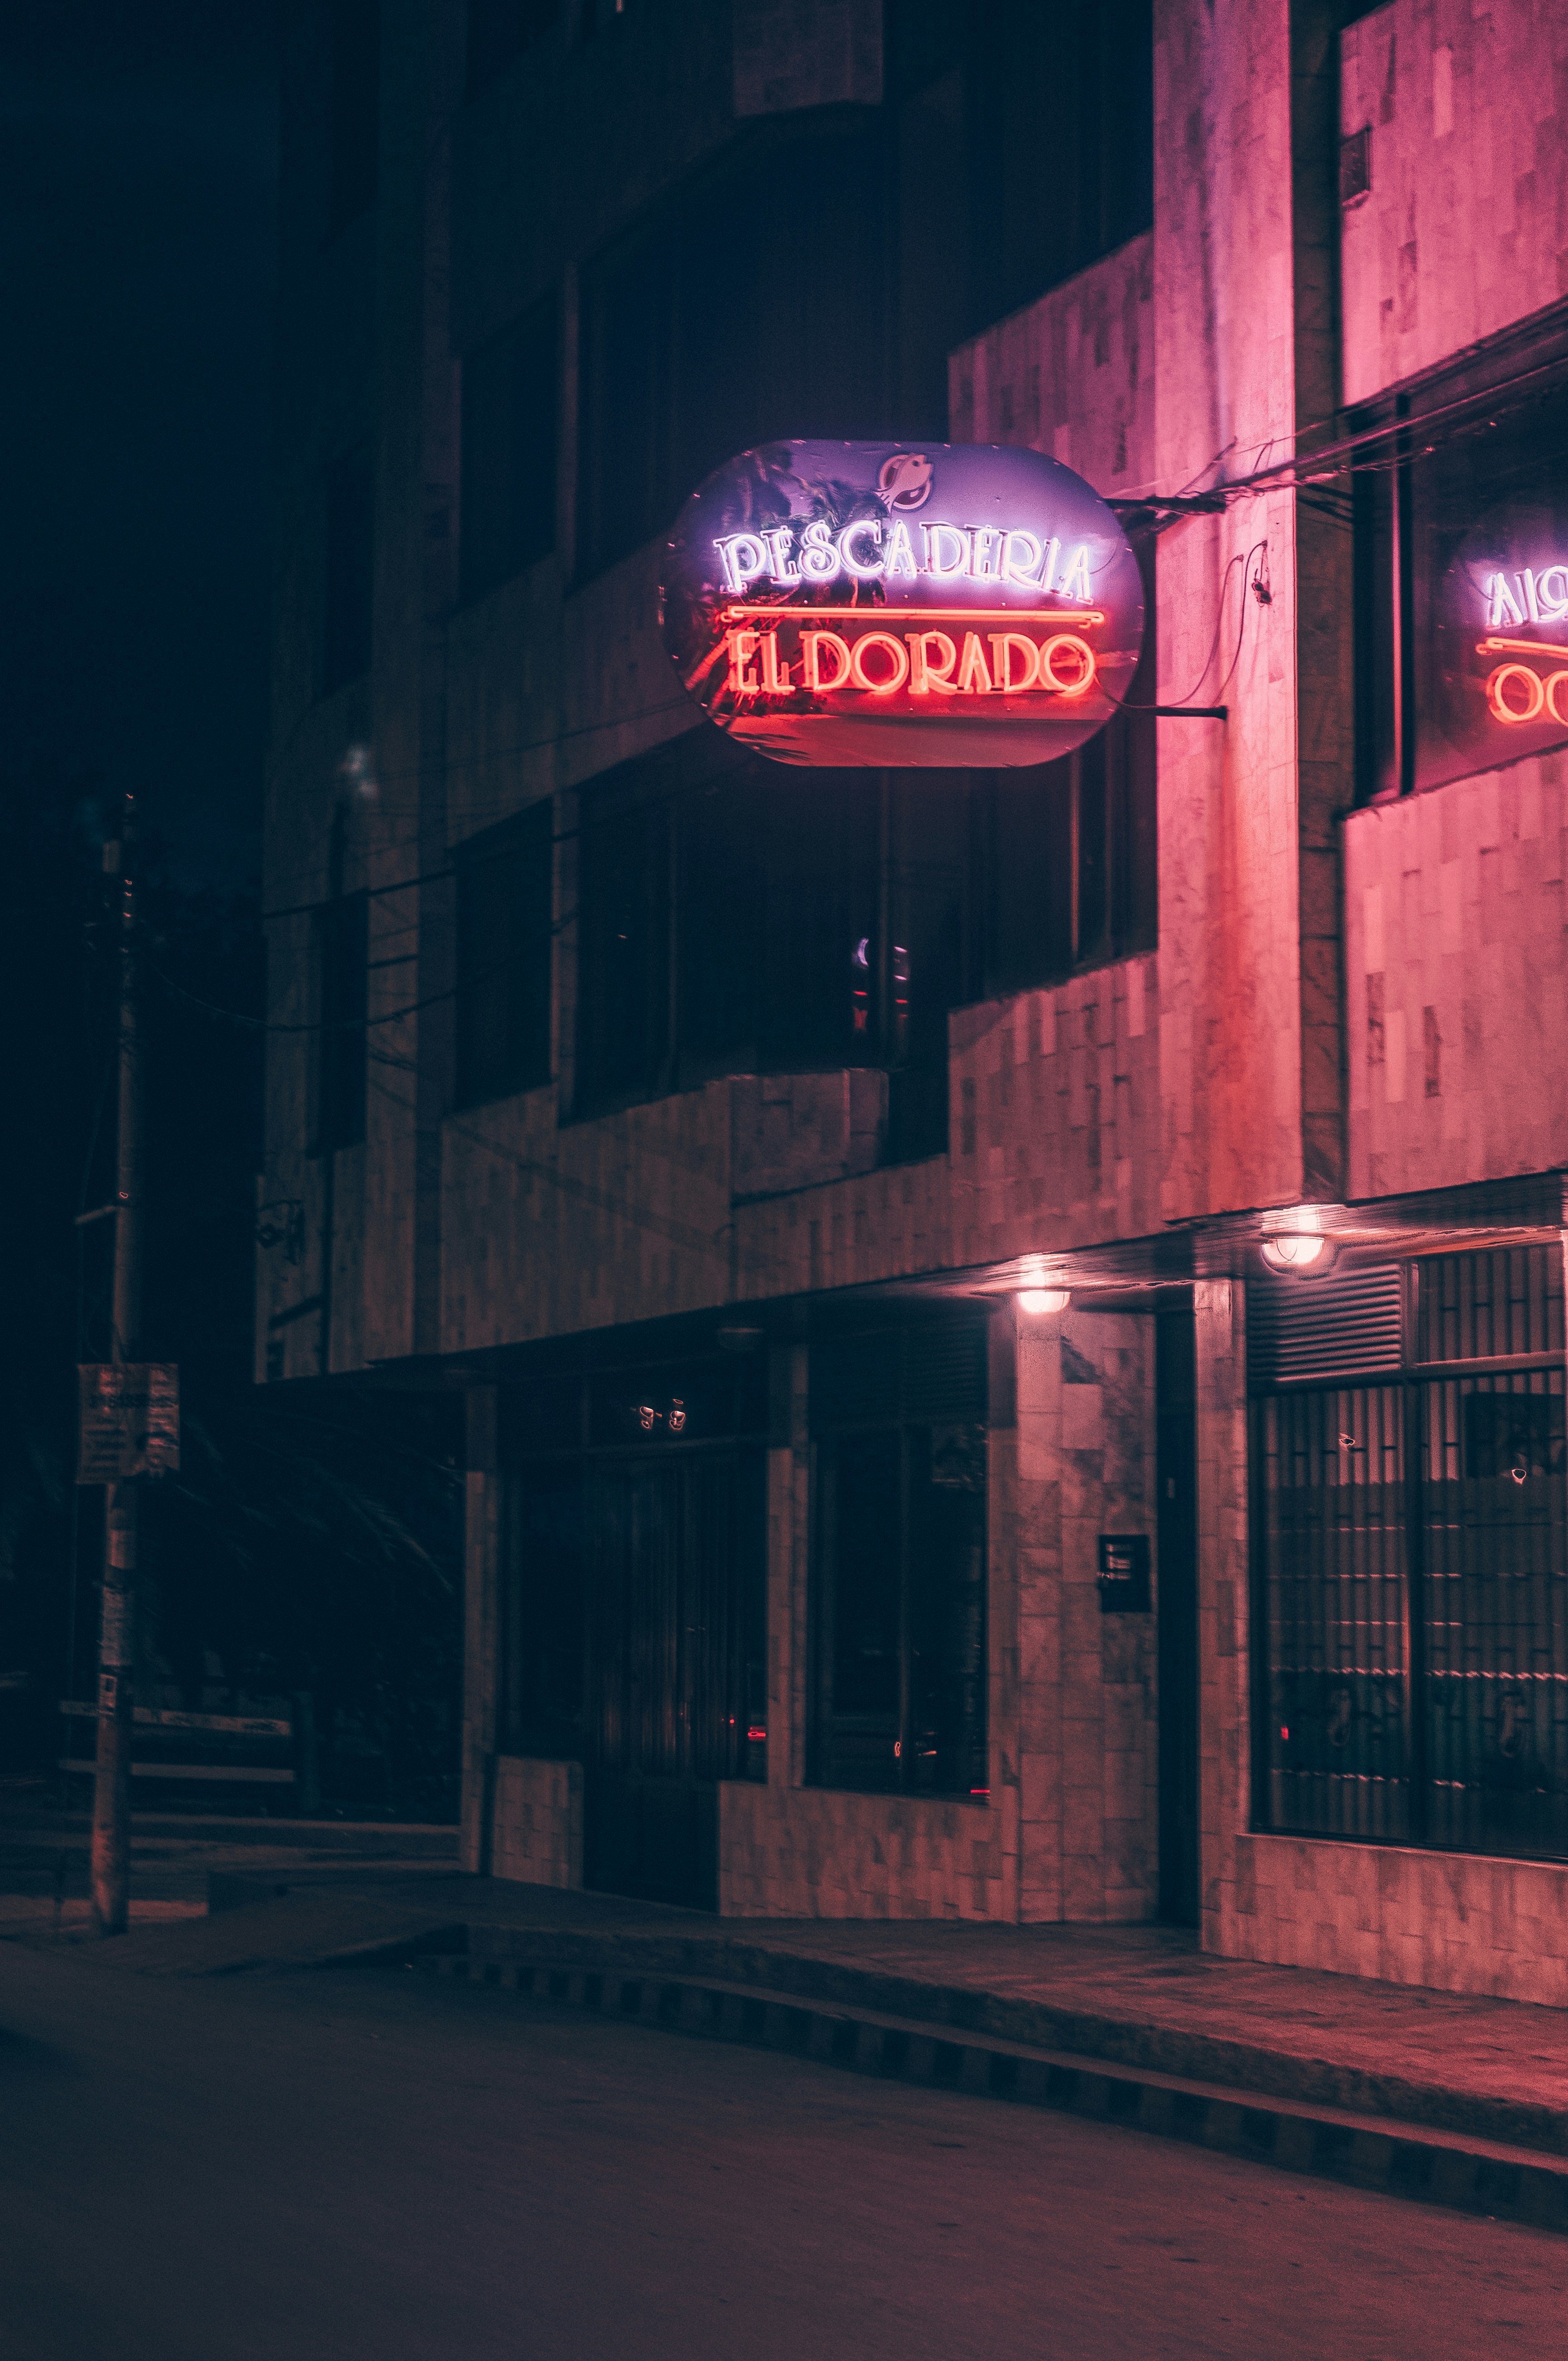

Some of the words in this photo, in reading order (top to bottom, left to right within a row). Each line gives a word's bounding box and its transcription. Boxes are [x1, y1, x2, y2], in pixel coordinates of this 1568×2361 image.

[713, 520, 1094, 605] PESCADERIA
[727, 629, 796, 695] EL
[803, 629, 1096, 696] DORADO
